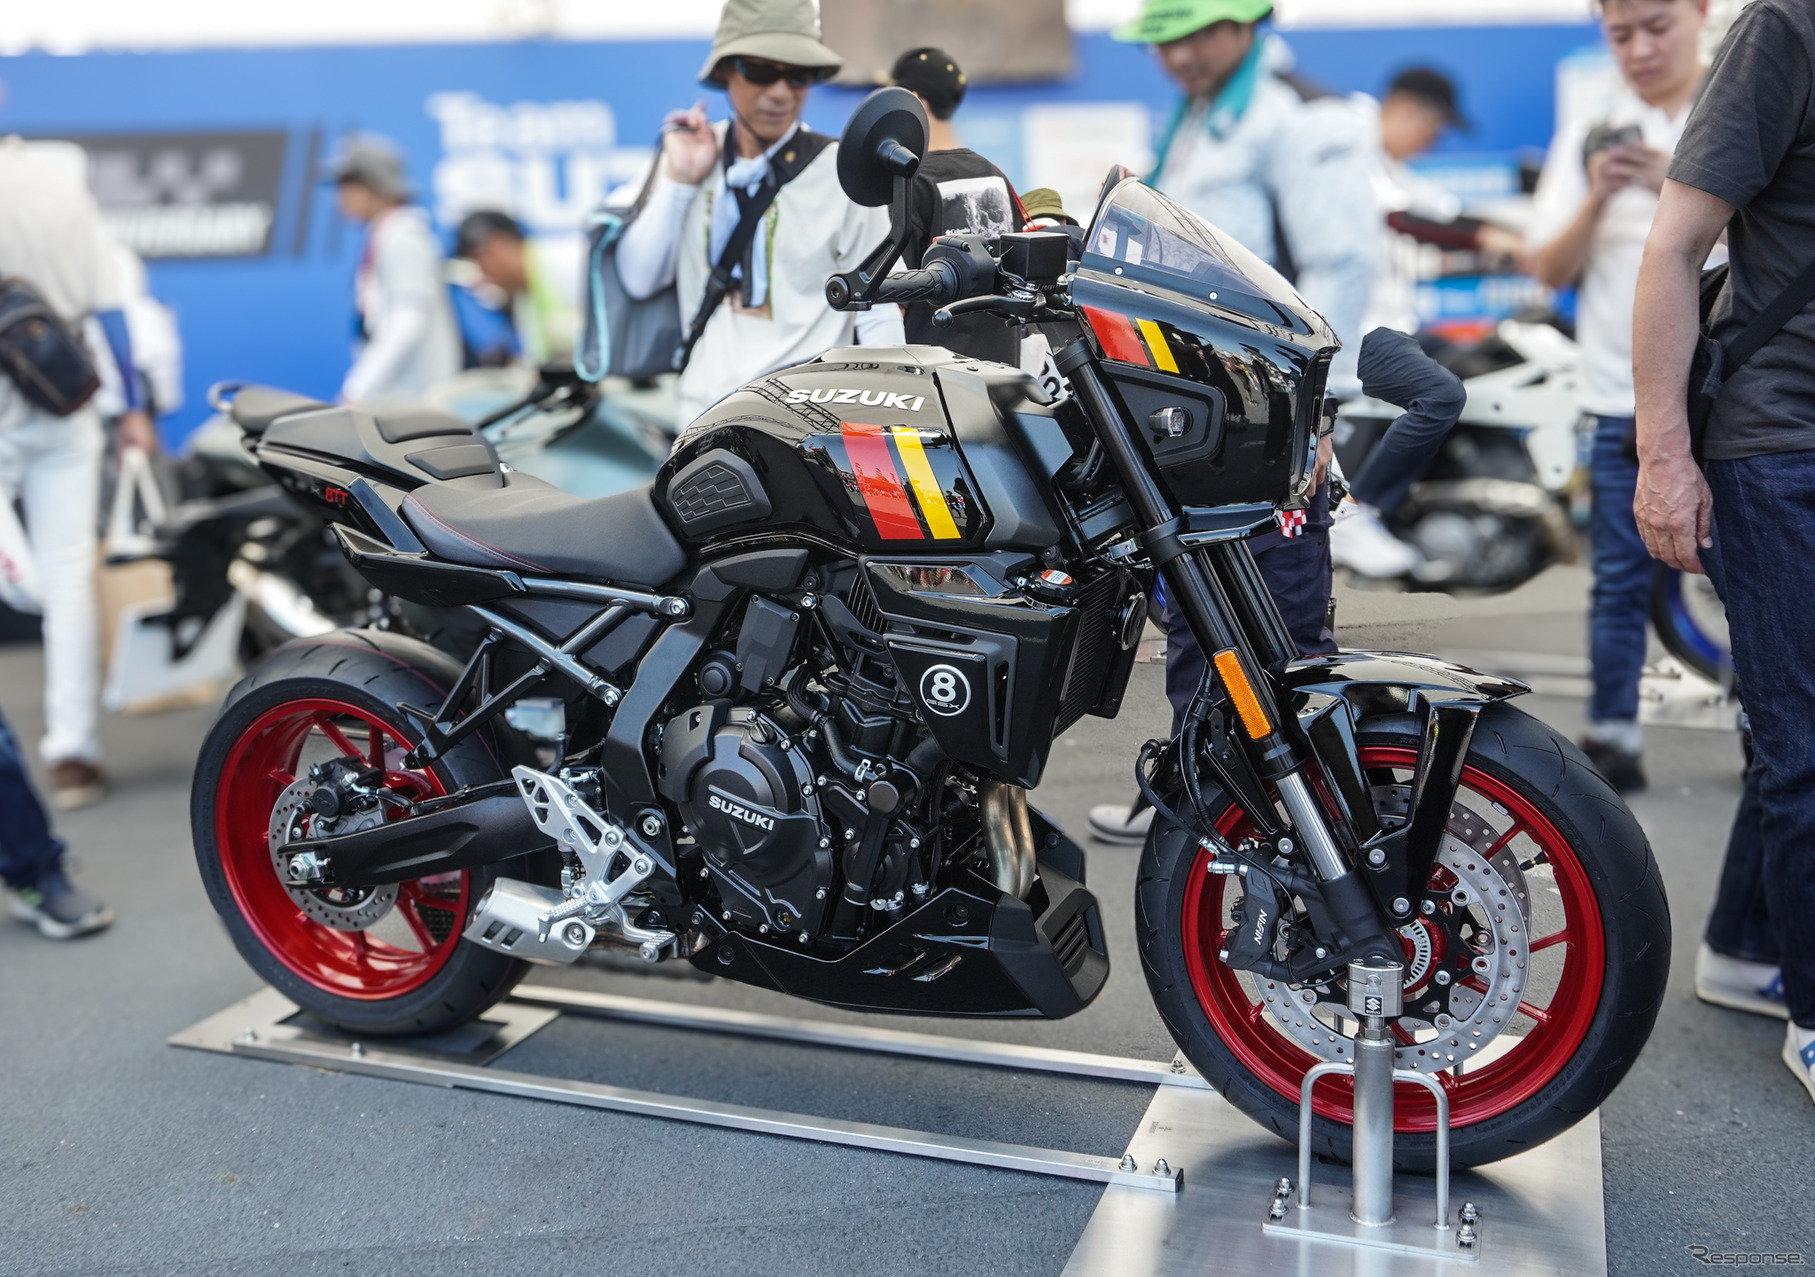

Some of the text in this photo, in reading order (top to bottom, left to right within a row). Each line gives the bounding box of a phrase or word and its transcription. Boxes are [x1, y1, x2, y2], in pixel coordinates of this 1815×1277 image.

[785, 388, 926, 413] SUZUKI
[325, 487, 348, 505] 8TT
[931, 672, 956, 702] 8
[708, 795, 775, 831] SUZUKI
